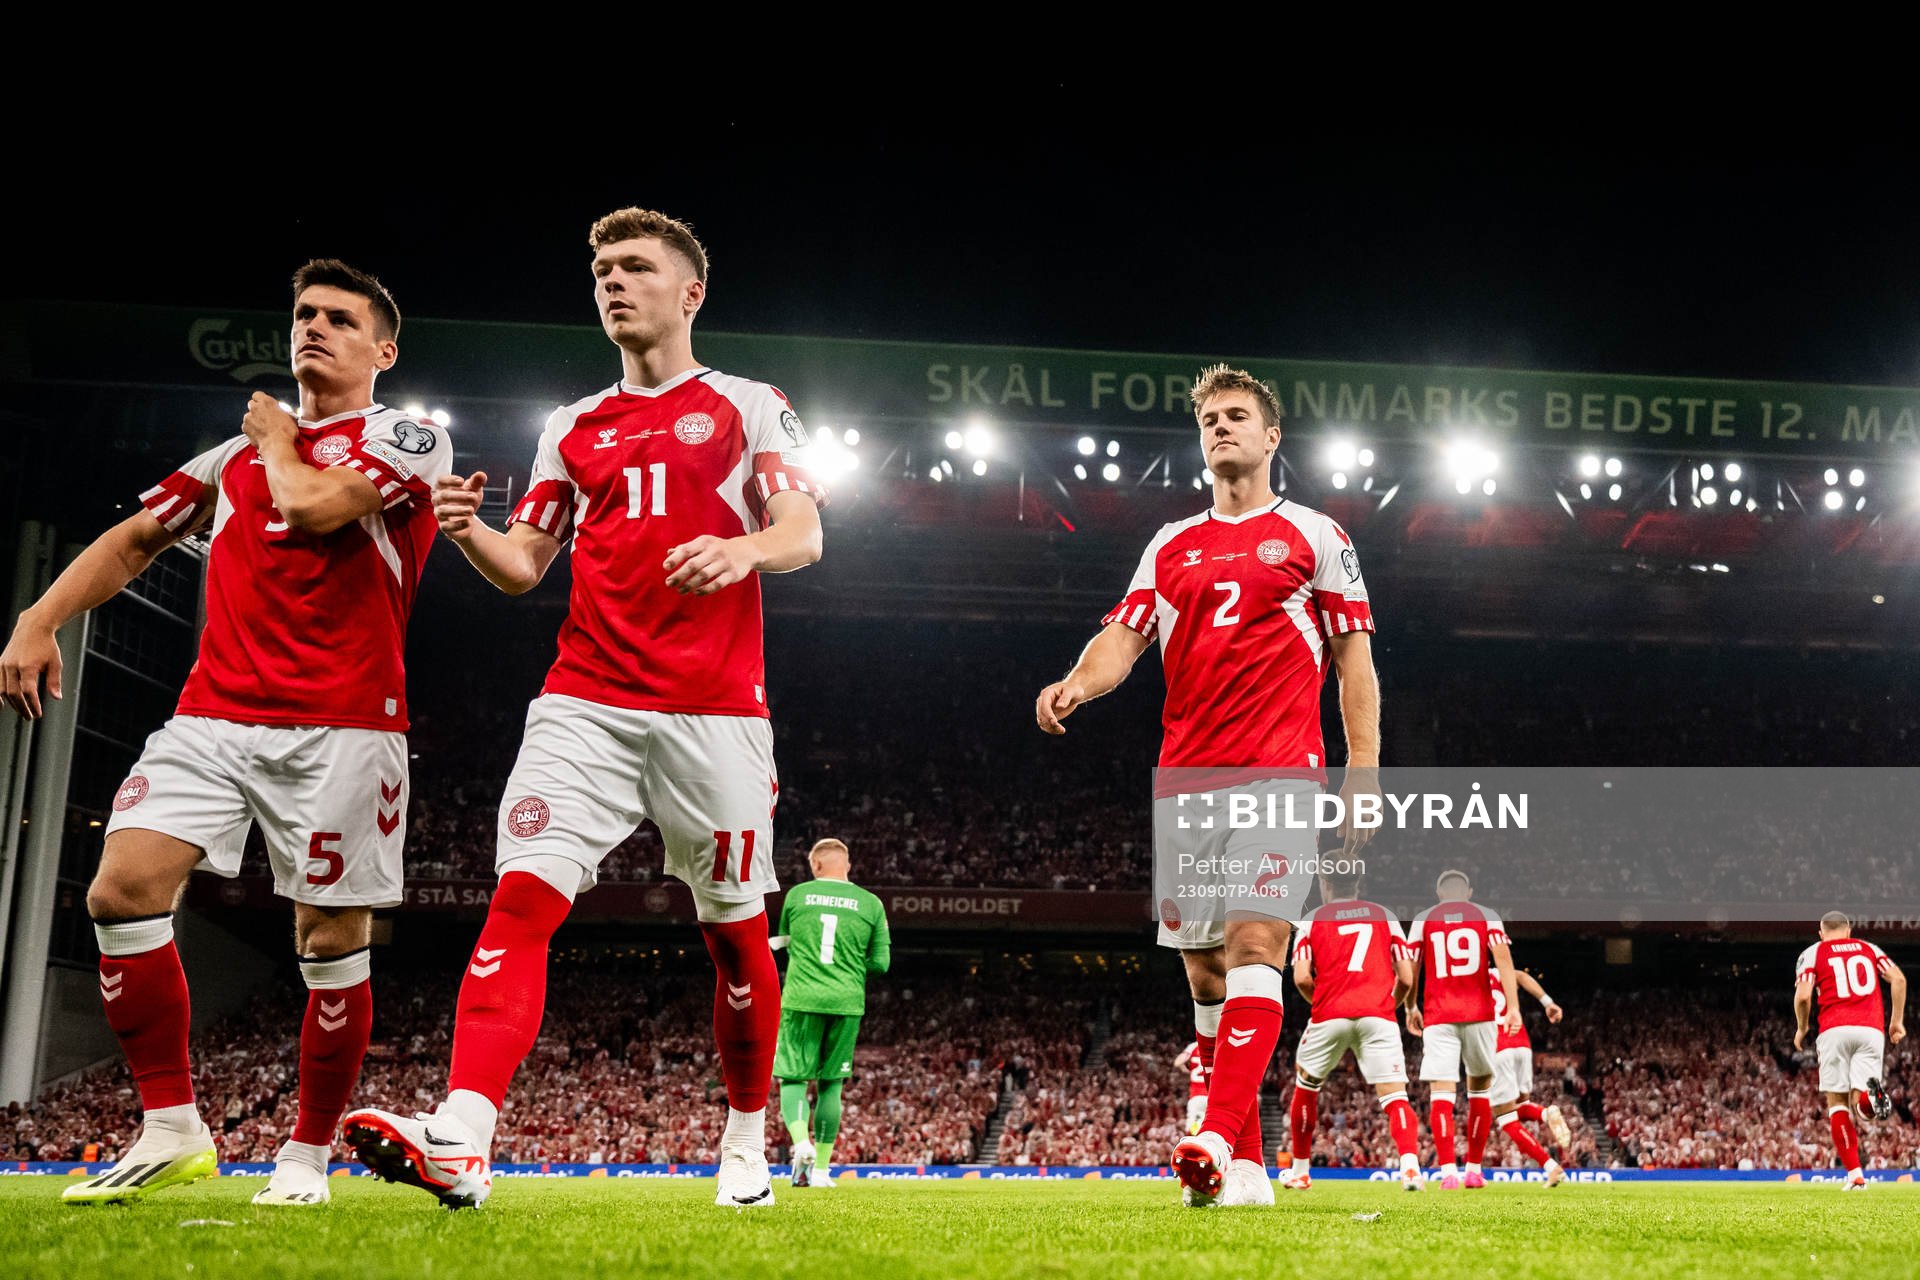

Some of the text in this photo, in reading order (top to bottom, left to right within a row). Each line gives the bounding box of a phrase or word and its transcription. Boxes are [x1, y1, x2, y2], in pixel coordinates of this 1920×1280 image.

[188, 318, 292, 369] Carlsb
[926, 363, 1065, 408] SKÅL
[1091, 372, 1192, 413] FOR
[1268, 377, 1519, 428] ANMARKS
[1544, 390, 1737, 437] BEDSTE
[1760, 401, 1817, 441] 12.
[623, 462, 667, 519] 11
[1213, 581, 1241, 627] 2
[516, 810, 540, 824] DBU
[306, 831, 344, 886] 5
[712, 830, 755, 882] 11
[417, 885, 457, 905] STÅ
[805, 894, 859, 911] SCHMEICHEL
[892, 897, 1023, 914] FOR HOLDET
[820, 913, 838, 964] 1
[1337, 923, 1373, 972] 7
[1430, 928, 1481, 979] 19
[1827, 954, 1877, 998] 10
